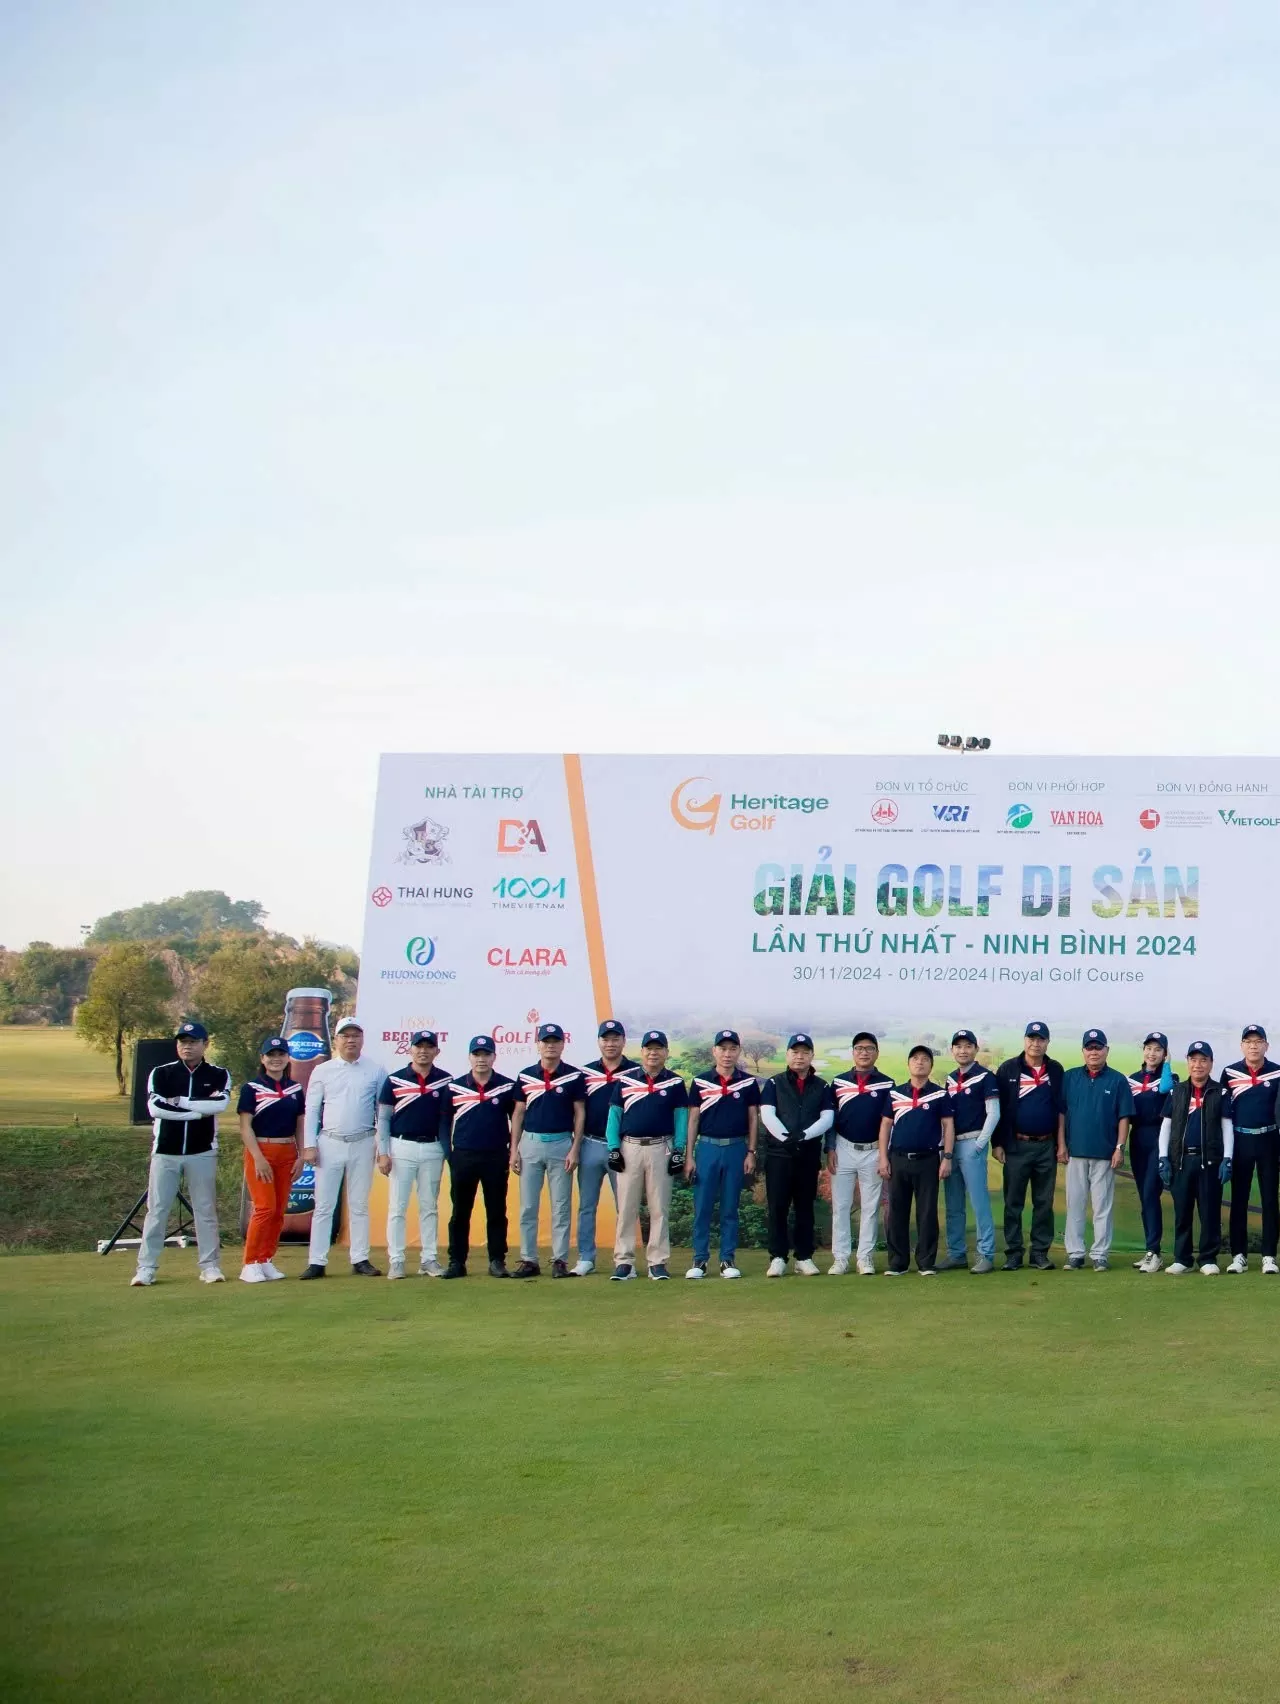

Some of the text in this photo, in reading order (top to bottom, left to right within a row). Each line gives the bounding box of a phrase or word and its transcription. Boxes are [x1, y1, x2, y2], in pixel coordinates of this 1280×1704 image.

[425, 783, 524, 802] NHÀ TÀI TRỢ
[731, 793, 829, 813] Heritage
[730, 814, 777, 831] Golf
[1253, 818, 1280, 826] GOLF
[492, 877, 567, 899] 1001
[753, 845, 1200, 919] GIẢI GOLF DI SẢN
[397, 887, 474, 899] THAI HUNG
[752, 923, 806, 953] LẦN
[816, 924, 874, 953] THỨ
[881, 924, 957, 954] NHẤT
[983, 933, 1050, 955] NINH
[1060, 928, 1127, 955] BÌNH
[1136, 935, 1197, 956] 2024
[487, 947, 568, 967] CLARA
[793, 966, 882, 981] 30/11/2024
[898, 966, 988, 981] 01/12/2024
[999, 967, 1044, 984] Royal
[1049, 968, 1082, 982] Golf
[1087, 968, 1145, 982] Course
[382, 1031, 449, 1042] BECT
[491, 1025, 532, 1044] GOLF
